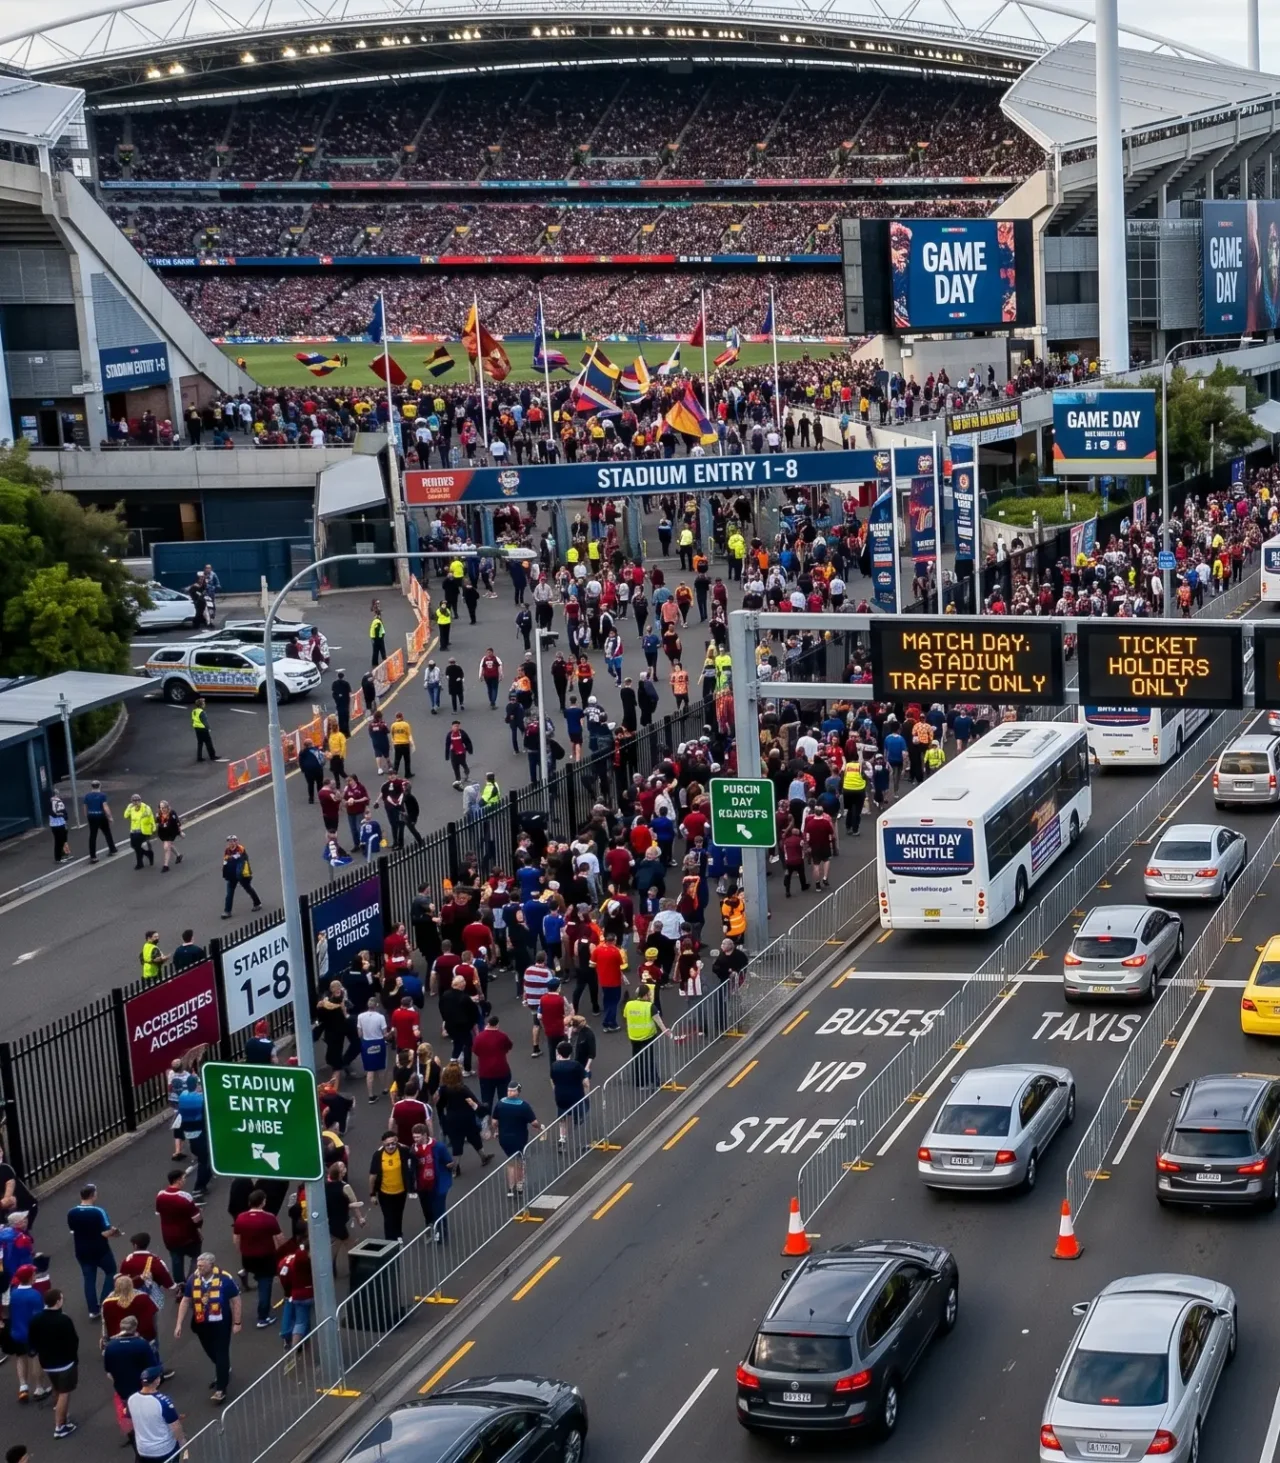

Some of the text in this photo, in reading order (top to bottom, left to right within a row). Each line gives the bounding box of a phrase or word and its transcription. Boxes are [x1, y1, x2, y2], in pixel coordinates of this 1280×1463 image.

[922, 241, 987, 273] GAME
[1209, 237, 1243, 269] GAME
[934, 273, 978, 305] DAY
[1216, 271, 1238, 304] DAY
[1067, 410, 1141, 428] GAME DAY
[597, 465, 688, 489] STADIUM
[693, 461, 756, 483] ENTRY
[902, 633, 974, 651] MATCH
[1118, 636, 1198, 655] TICKET
[919, 652, 1014, 672] STADIUM
[1108, 657, 1209, 677] HOLDERS
[889, 672, 1046, 693] TRAFFIC ONLY
[1131, 678, 1188, 696] ONLY
[731, 797, 753, 807] DAY
[895, 833, 962, 846] MATCH DAY
[903, 847, 955, 859] SHUTTLE
[240, 959, 292, 1017] 1-8
[814, 1007, 945, 1037] BUSES
[1031, 1011, 1142, 1043] TAXIS
[150, 1015, 199, 1053] ACCESS
[221, 1074, 295, 1093] STADIUM
[796, 1060, 867, 1093] VIP
[228, 1095, 292, 1114] ENTRY
